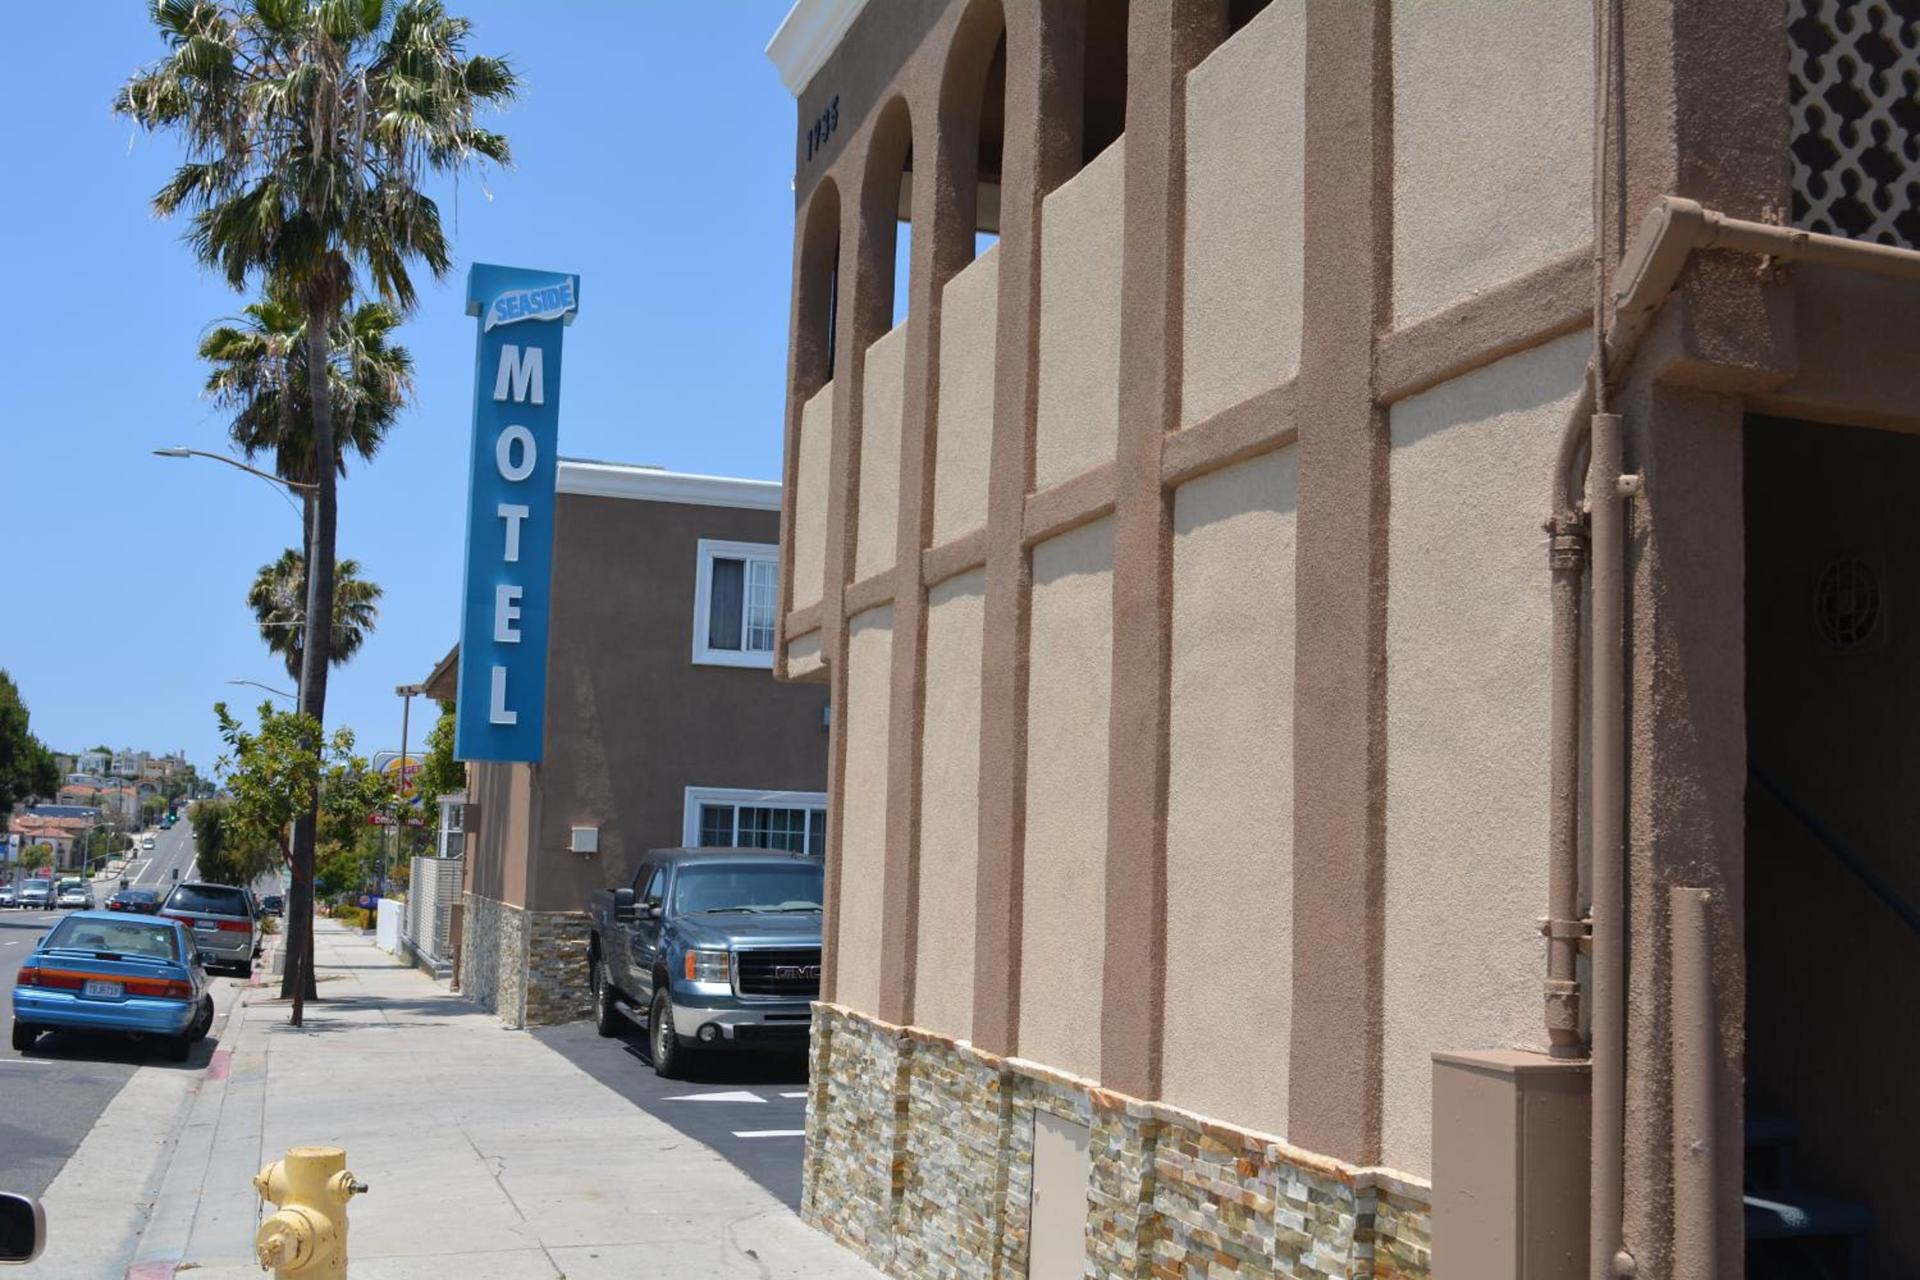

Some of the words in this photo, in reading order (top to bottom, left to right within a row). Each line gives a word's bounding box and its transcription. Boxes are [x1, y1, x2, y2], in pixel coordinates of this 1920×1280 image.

[494, 282, 574, 322] SEASIDE
[489, 343, 545, 726] MOTEL
[775, 965, 822, 980] GMC
